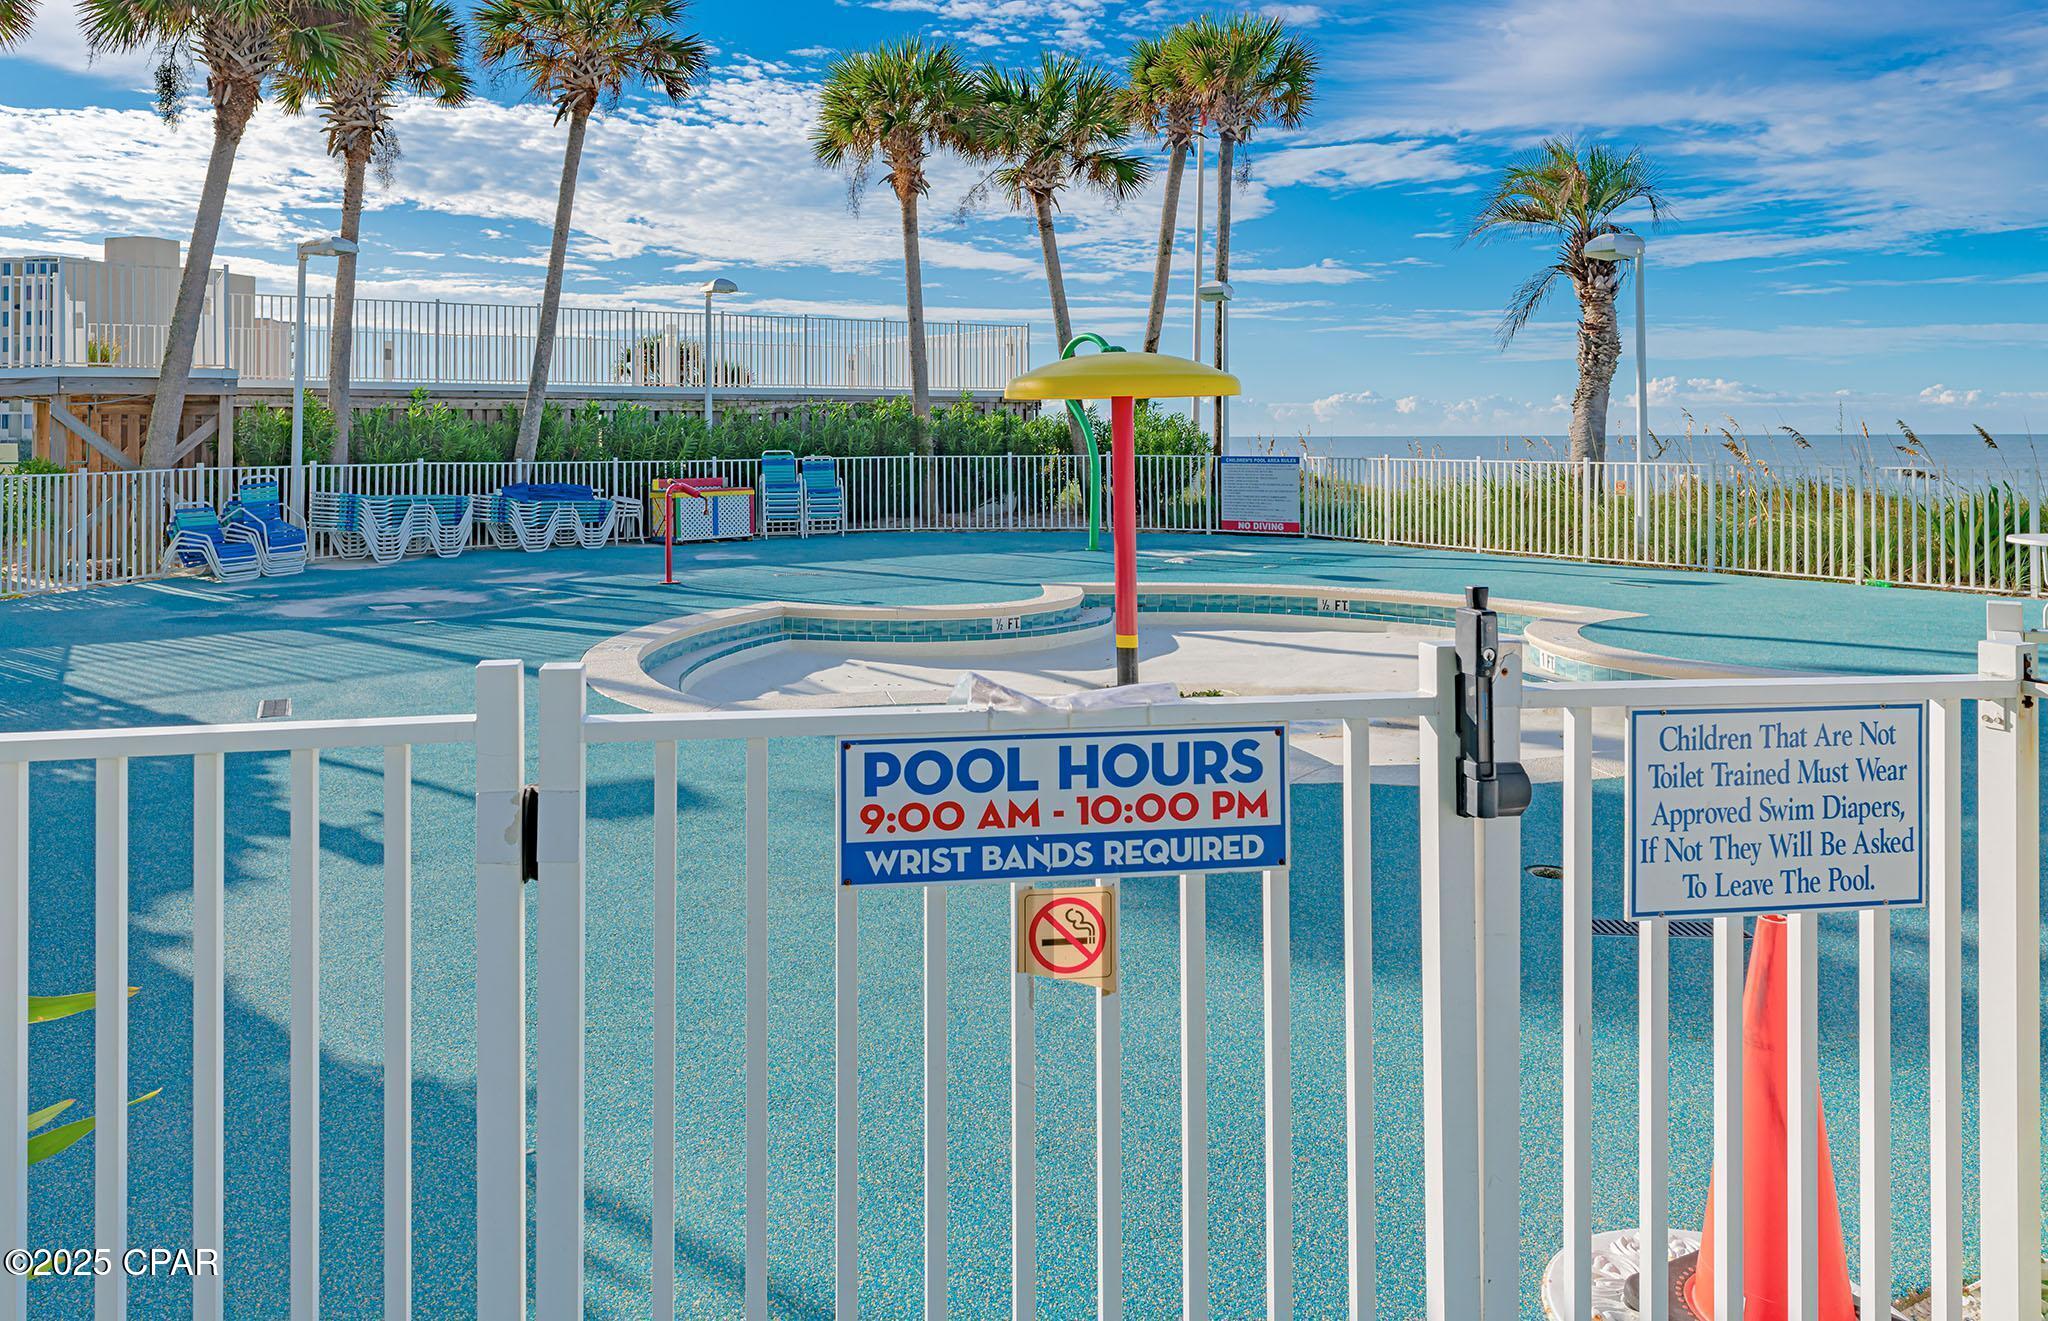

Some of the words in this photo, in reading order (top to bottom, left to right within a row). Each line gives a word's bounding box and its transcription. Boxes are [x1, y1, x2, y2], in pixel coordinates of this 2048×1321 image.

[1238, 521, 1251, 530] NO
[1253, 522, 1285, 531] DIVING
[1334, 599, 1349, 612] FT.
[1659, 724, 1752, 752] Children
[1759, 722, 1808, 749] That
[1813, 723, 1853, 748] Are
[1860, 721, 1897, 746] Not
[864, 747, 1039, 797] POOL
[1059, 739, 1264, 790] HOURS
[1648, 761, 1704, 789] Toilet
[1711, 758, 1790, 787] Trained
[1797, 759, 1849, 784] Must
[1856, 757, 1908, 782] Wear
[860, 801, 965, 834] 9:00
[977, 798, 1041, 830] AM
[1076, 791, 1200, 825] 10:00
[1212, 789, 1269, 820] PM
[1651, 797, 1751, 832] Approved
[1759, 797, 1815, 823] Swim
[1822, 794, 1905, 825] Diapers,
[865, 846, 971, 876] WRIST
[982, 840, 1094, 873] BANDS
[1104, 834, 1265, 866] REQUIRED
[1640, 836, 1659, 864] If
[1664, 836, 1703, 863] Not
[1710, 833, 1762, 866] They
[1768, 830, 1813, 859] Will
[1820, 831, 1846, 856] Be
[1853, 826, 1915, 854] Asked
[1682, 873, 1707, 899] To
[1715, 872, 1773, 897] Leave
[1780, 867, 1821, 894] The
[1828, 864, 1875, 892] Pool.
